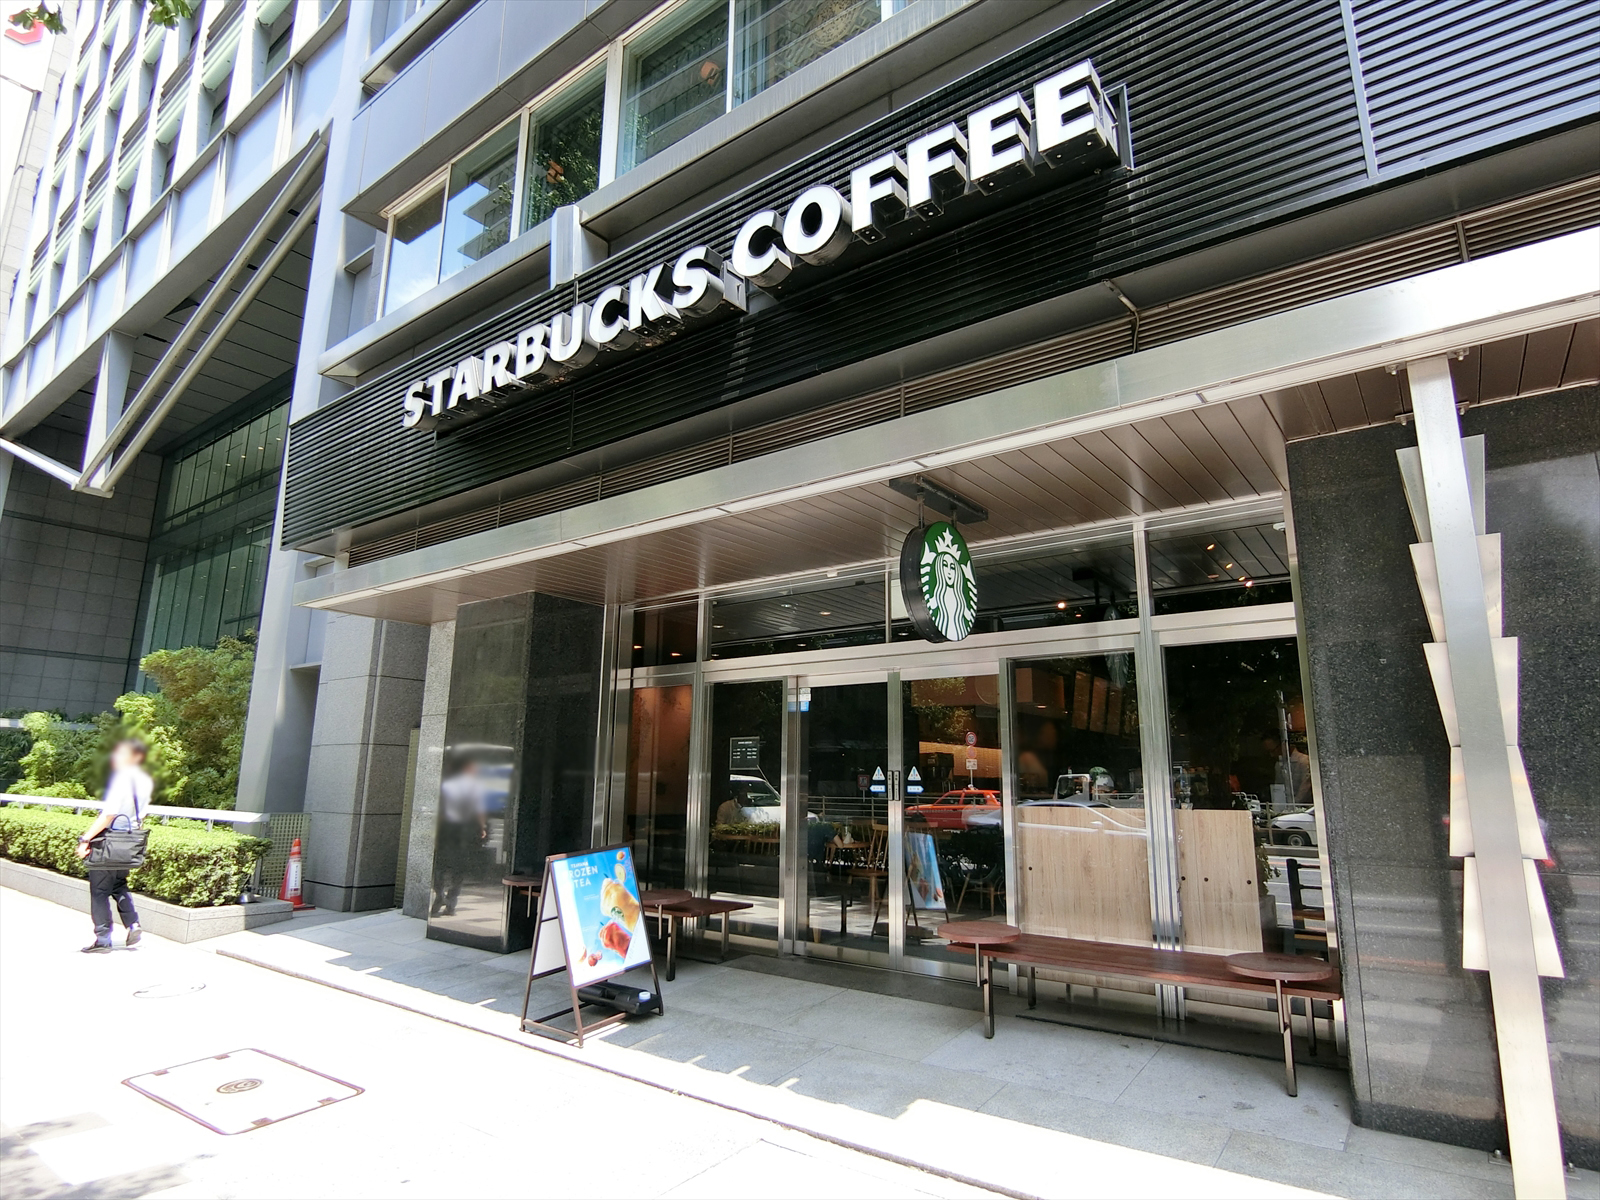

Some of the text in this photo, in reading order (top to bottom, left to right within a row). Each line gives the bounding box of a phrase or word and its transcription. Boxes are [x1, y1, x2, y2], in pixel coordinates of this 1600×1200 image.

[402, 58, 1099, 428] STARBUCKS COFFEE
[564, 866, 598, 878] ROZEN
[574, 879, 591, 888] TEA
